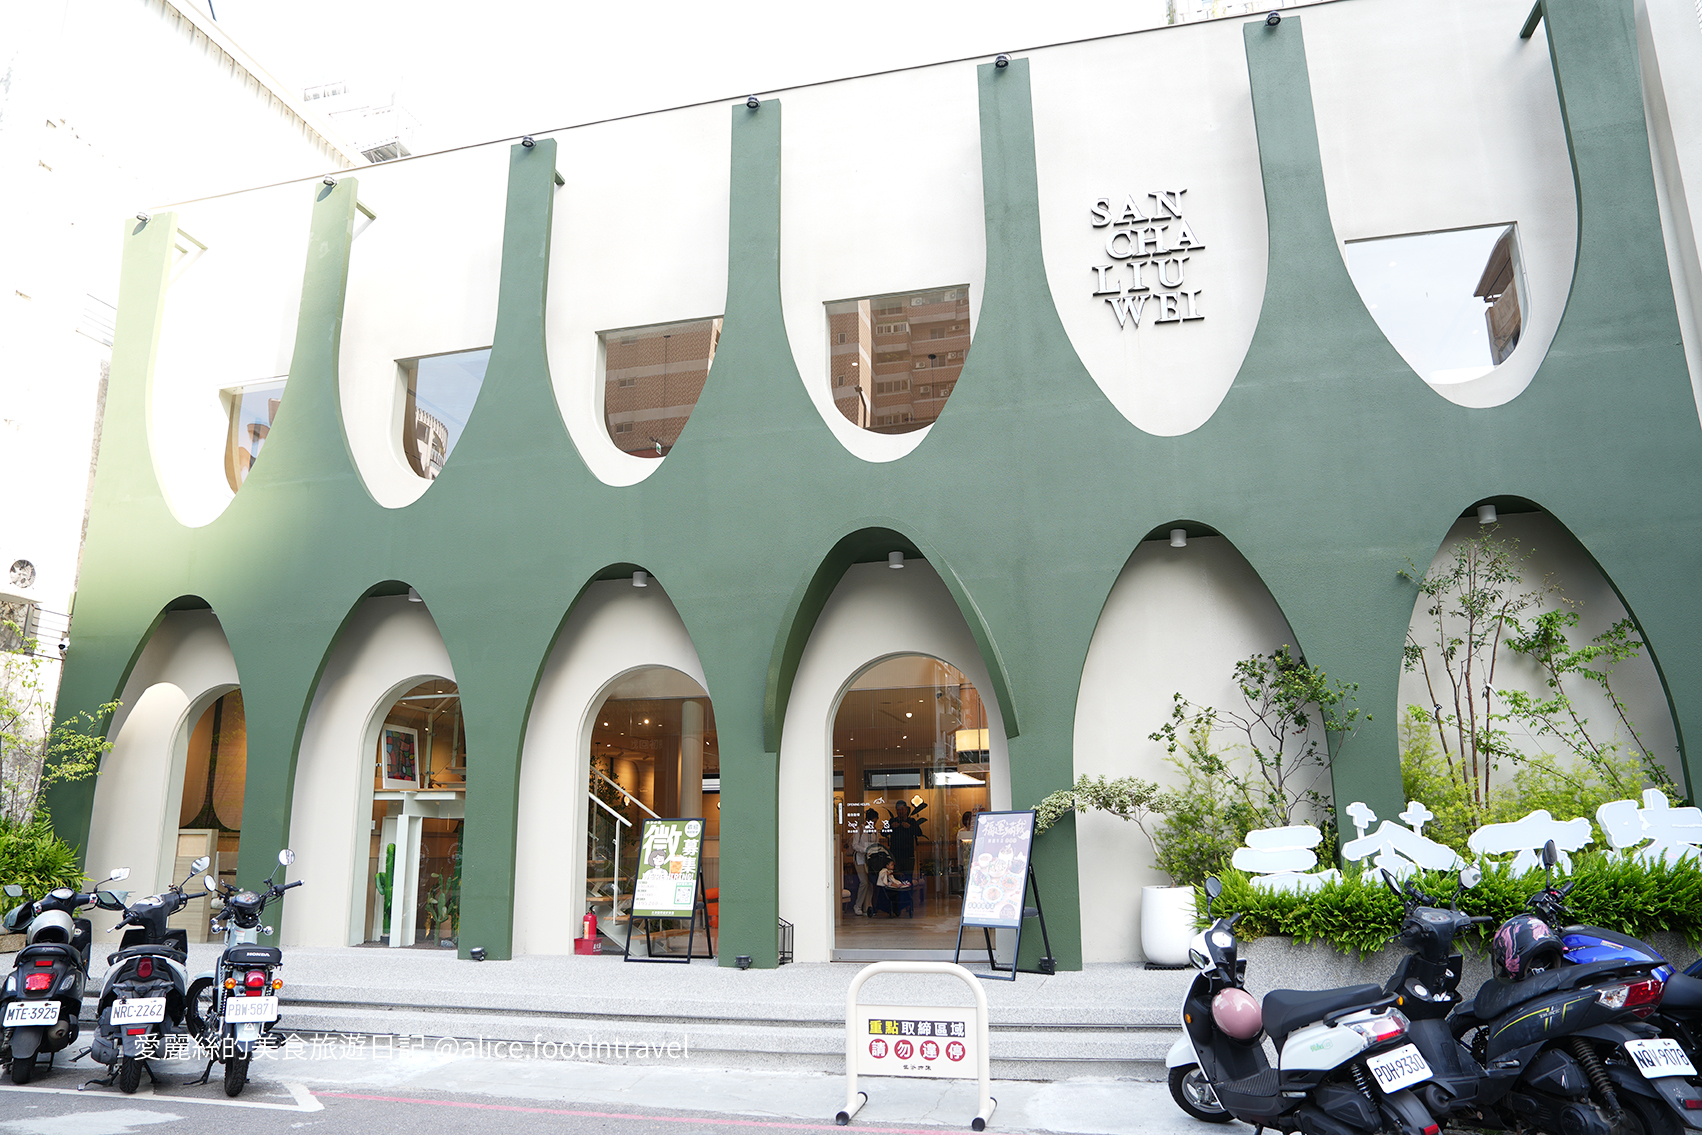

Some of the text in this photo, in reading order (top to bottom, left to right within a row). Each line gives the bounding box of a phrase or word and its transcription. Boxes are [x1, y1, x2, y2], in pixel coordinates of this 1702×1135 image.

[1091, 188, 1188, 229] SAN
[1105, 220, 1206, 261] CHA
[1091, 256, 1190, 297] LIU
[1104, 289, 1205, 330] WEI
[869, 1020, 965, 1037] 重點取締區域
[870, 1041, 964, 1060] 請勿違停
